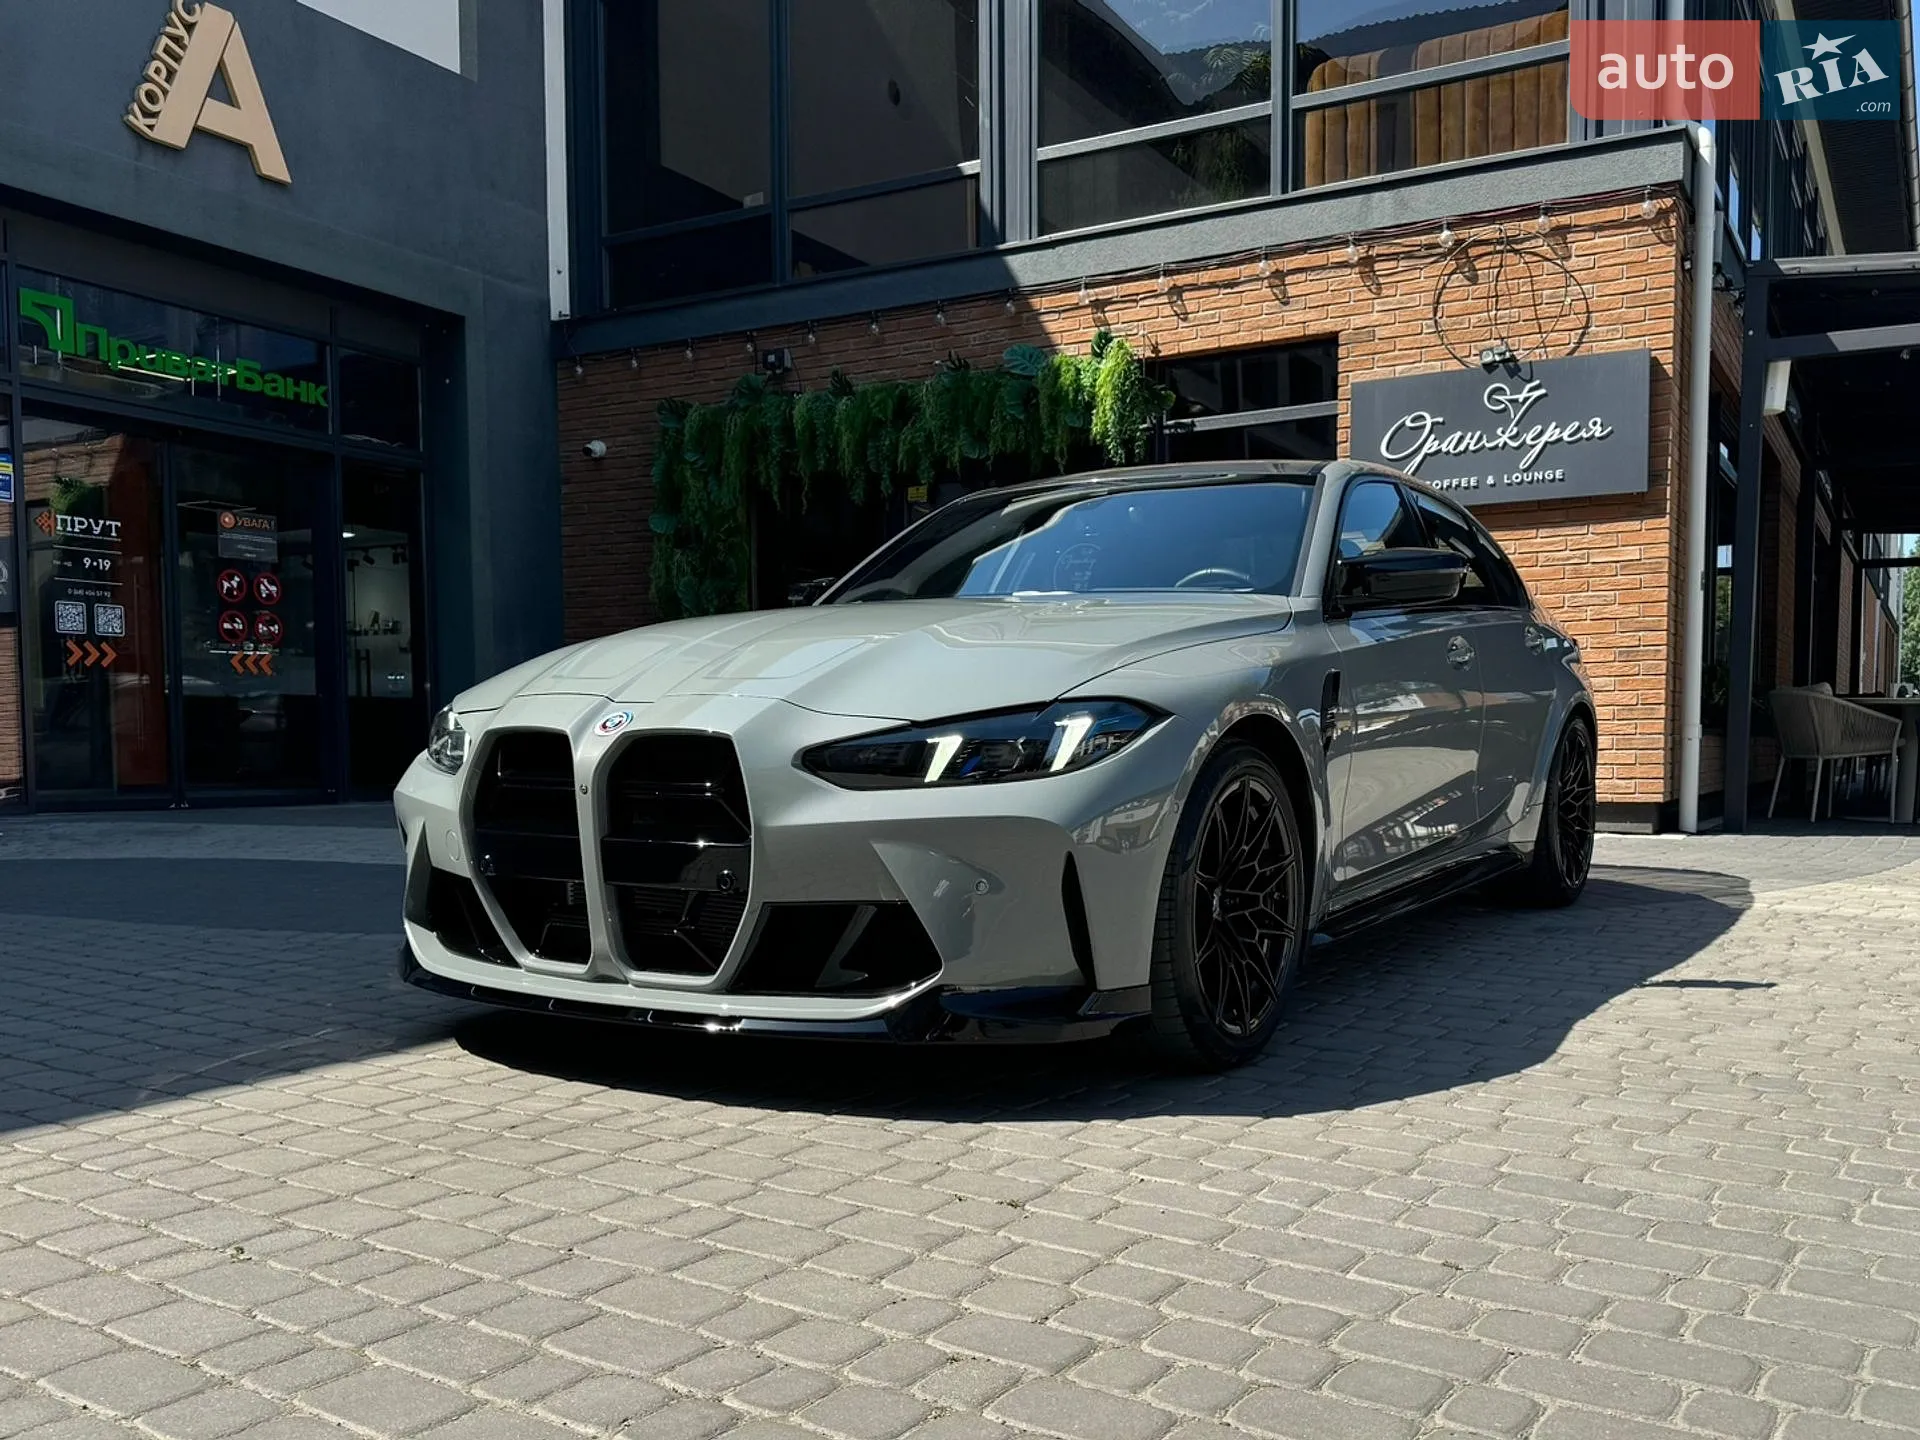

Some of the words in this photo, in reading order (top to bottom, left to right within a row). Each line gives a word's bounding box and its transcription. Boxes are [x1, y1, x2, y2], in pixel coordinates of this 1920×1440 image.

[123, 0, 200, 140] КОРПУС
[75, 322, 329, 408] ПриватБанк
[1380, 382, 1613, 477] Оранжерея
[1425, 476, 1479, 490] OFFEE
[1486, 475, 1495, 486] &
[1503, 468, 1565, 484] LOUNGE
[56, 514, 122, 537] ПРУТ
